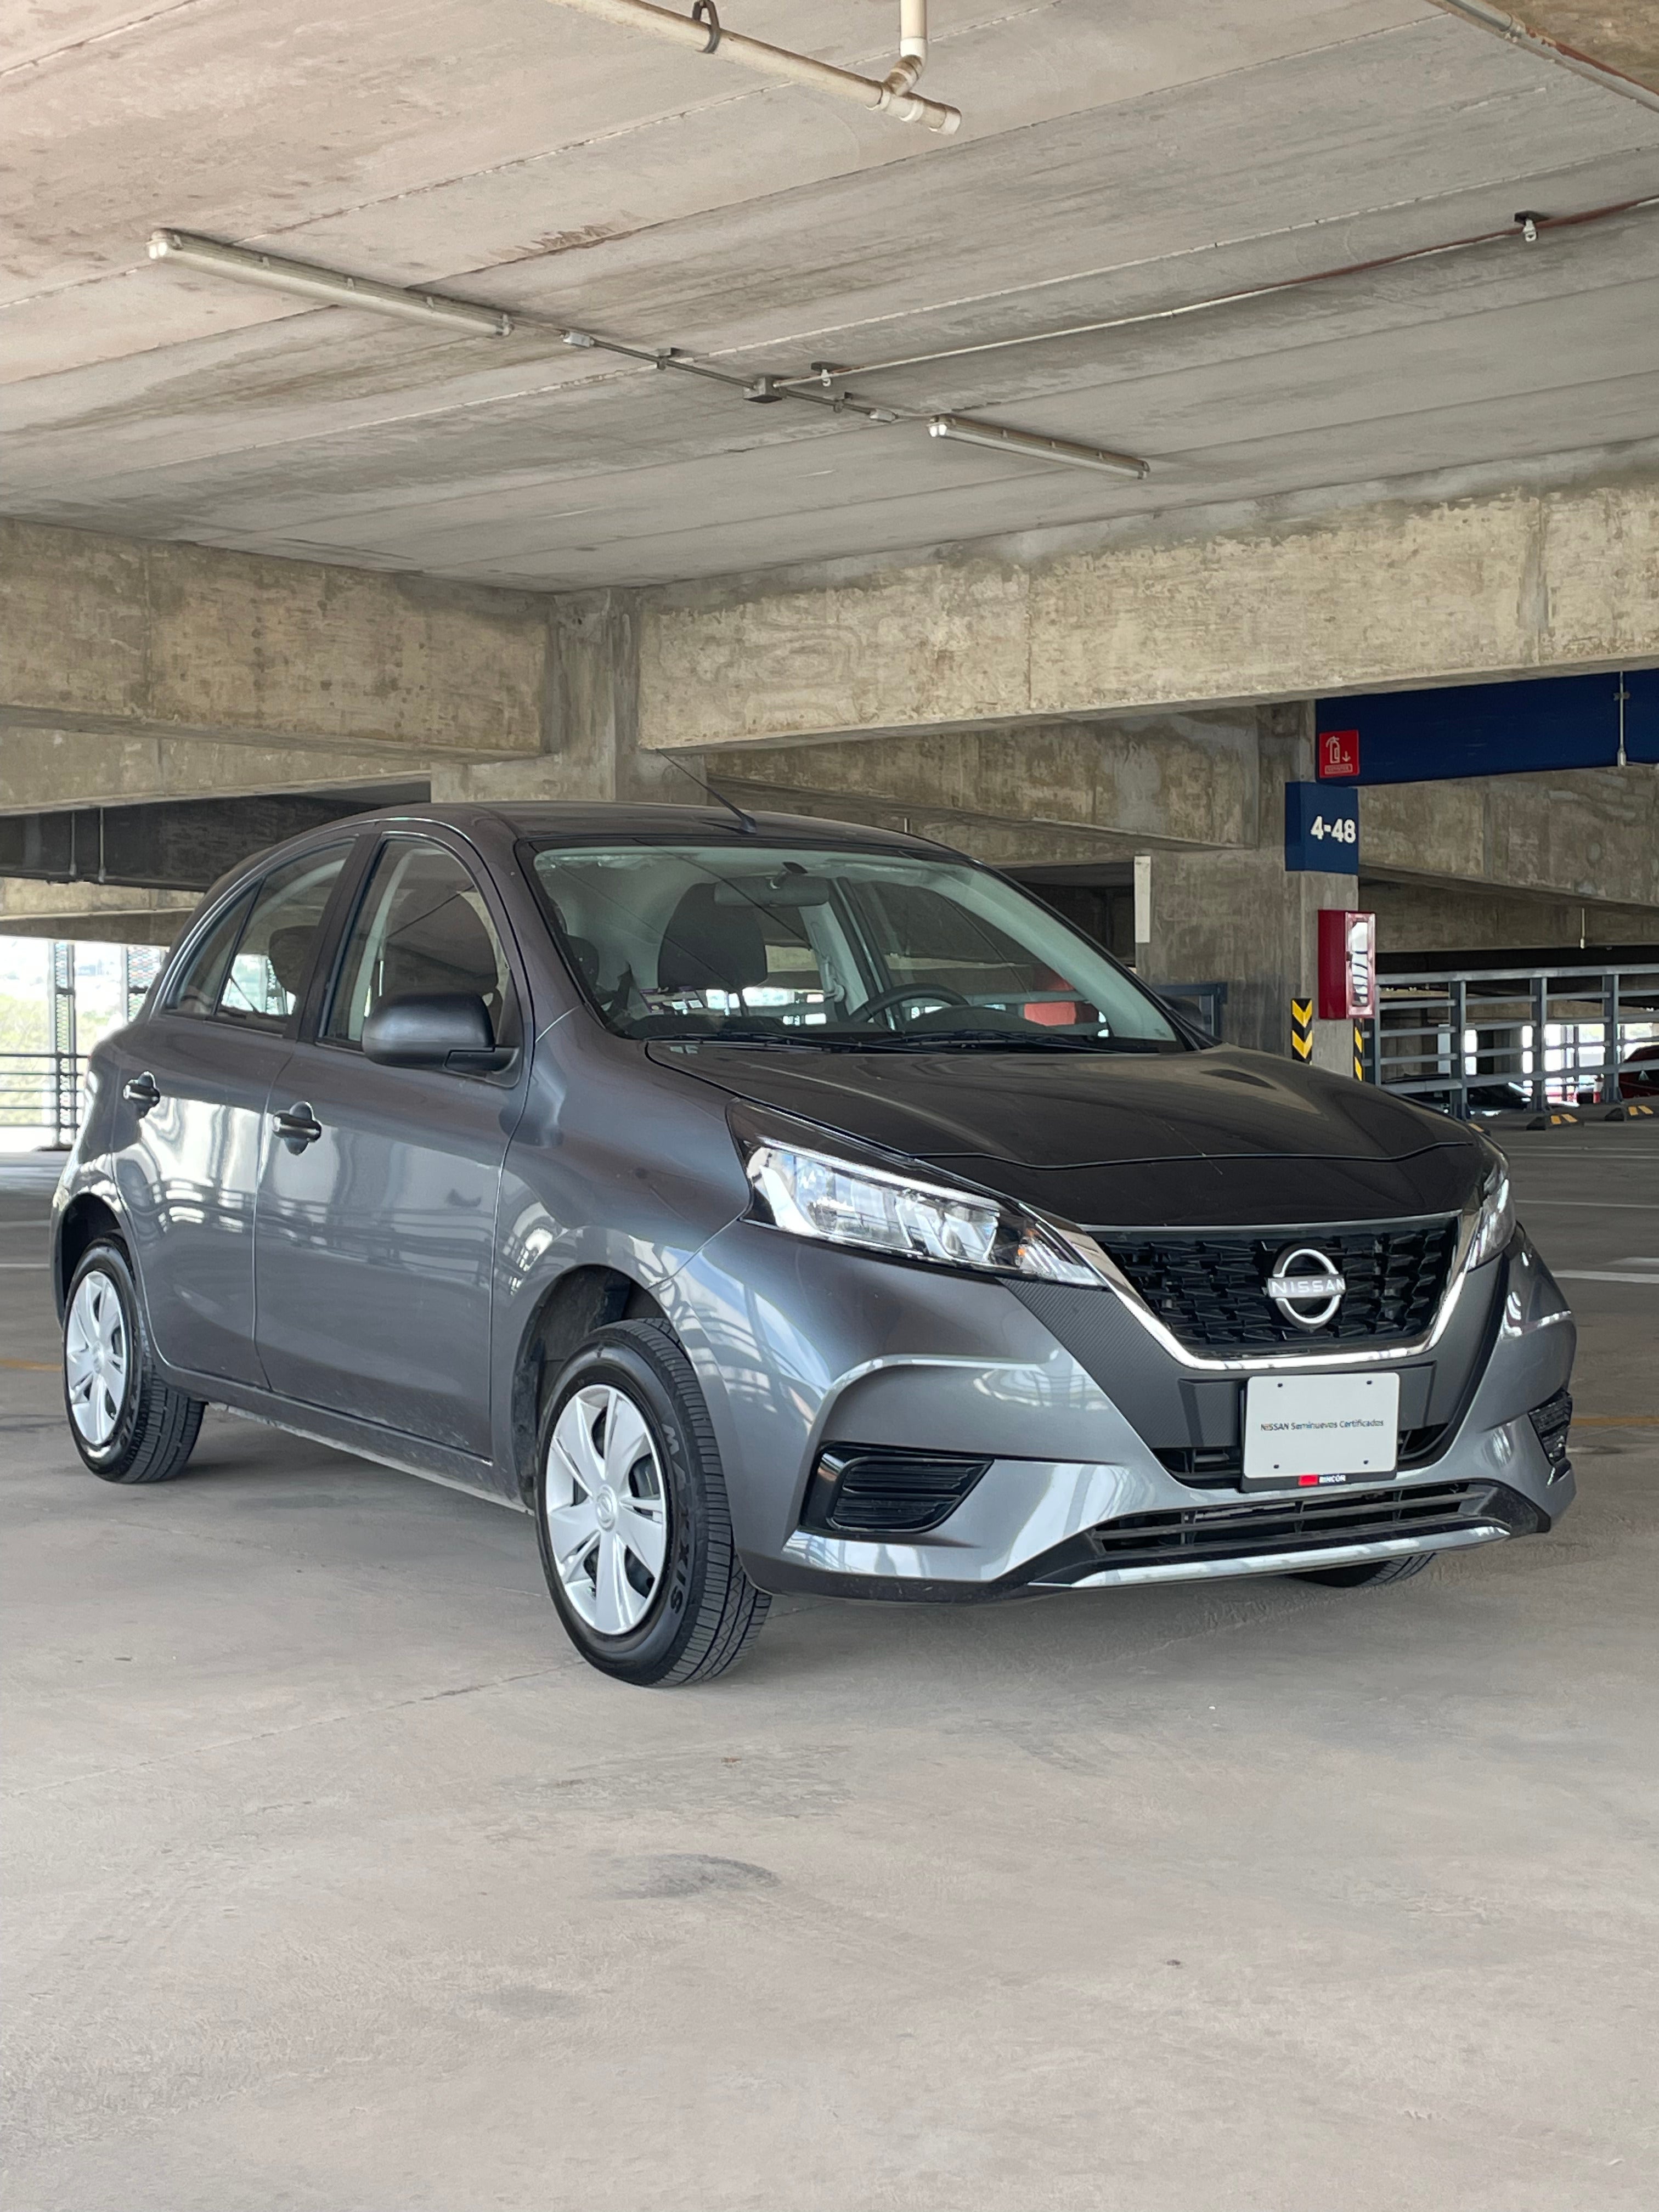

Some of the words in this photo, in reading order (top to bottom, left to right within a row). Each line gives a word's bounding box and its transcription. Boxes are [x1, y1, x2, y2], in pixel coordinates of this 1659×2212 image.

[1310, 816, 1356, 843] 4-48
[1271, 1278, 1346, 1294] NISSAN
[1261, 1423, 1289, 1431] NISSAN
